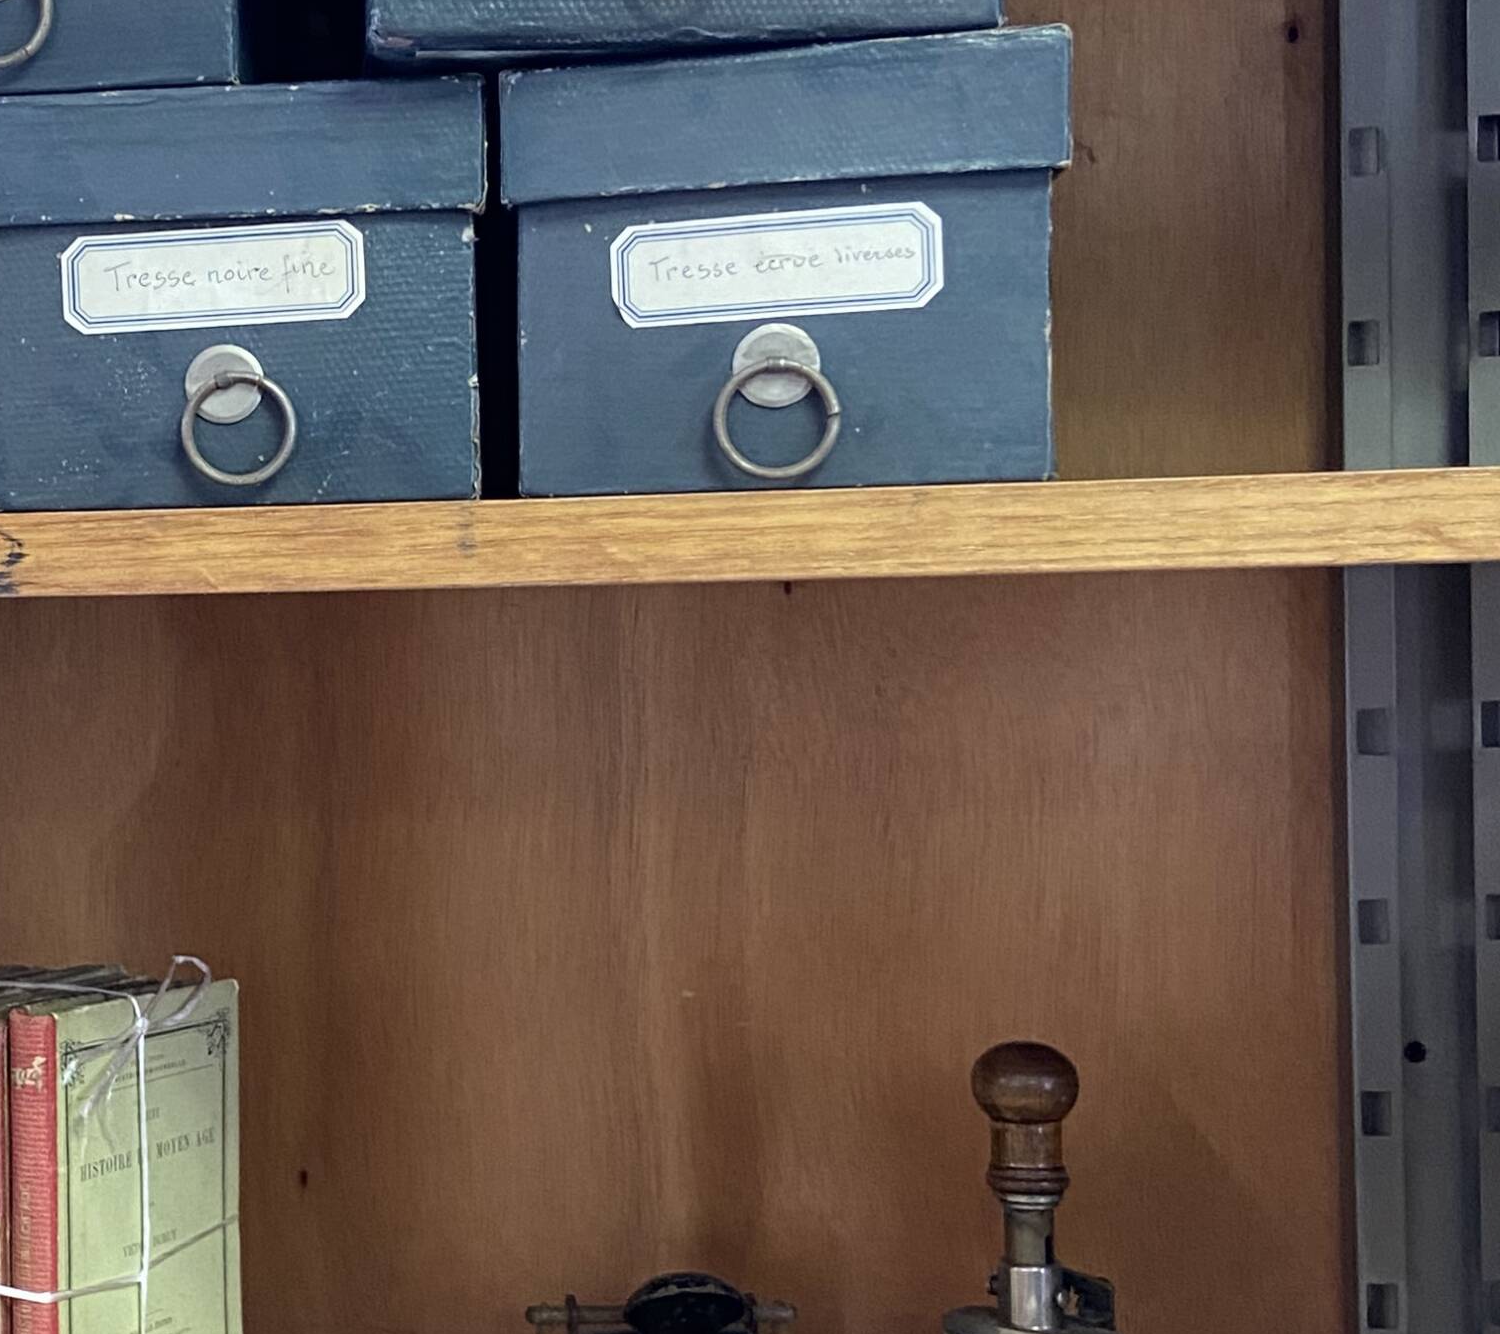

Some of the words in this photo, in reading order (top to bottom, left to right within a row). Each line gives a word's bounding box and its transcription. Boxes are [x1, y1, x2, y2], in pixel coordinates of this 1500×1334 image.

[103, 261, 198, 292] Tresse
[207, 259, 274, 284] noire
[280, 249, 337, 294] fine
[647, 255, 739, 283] Tresse
[79, 1151, 133, 1183] HISTOIRE
[155, 1131, 190, 1159] MOYEN
